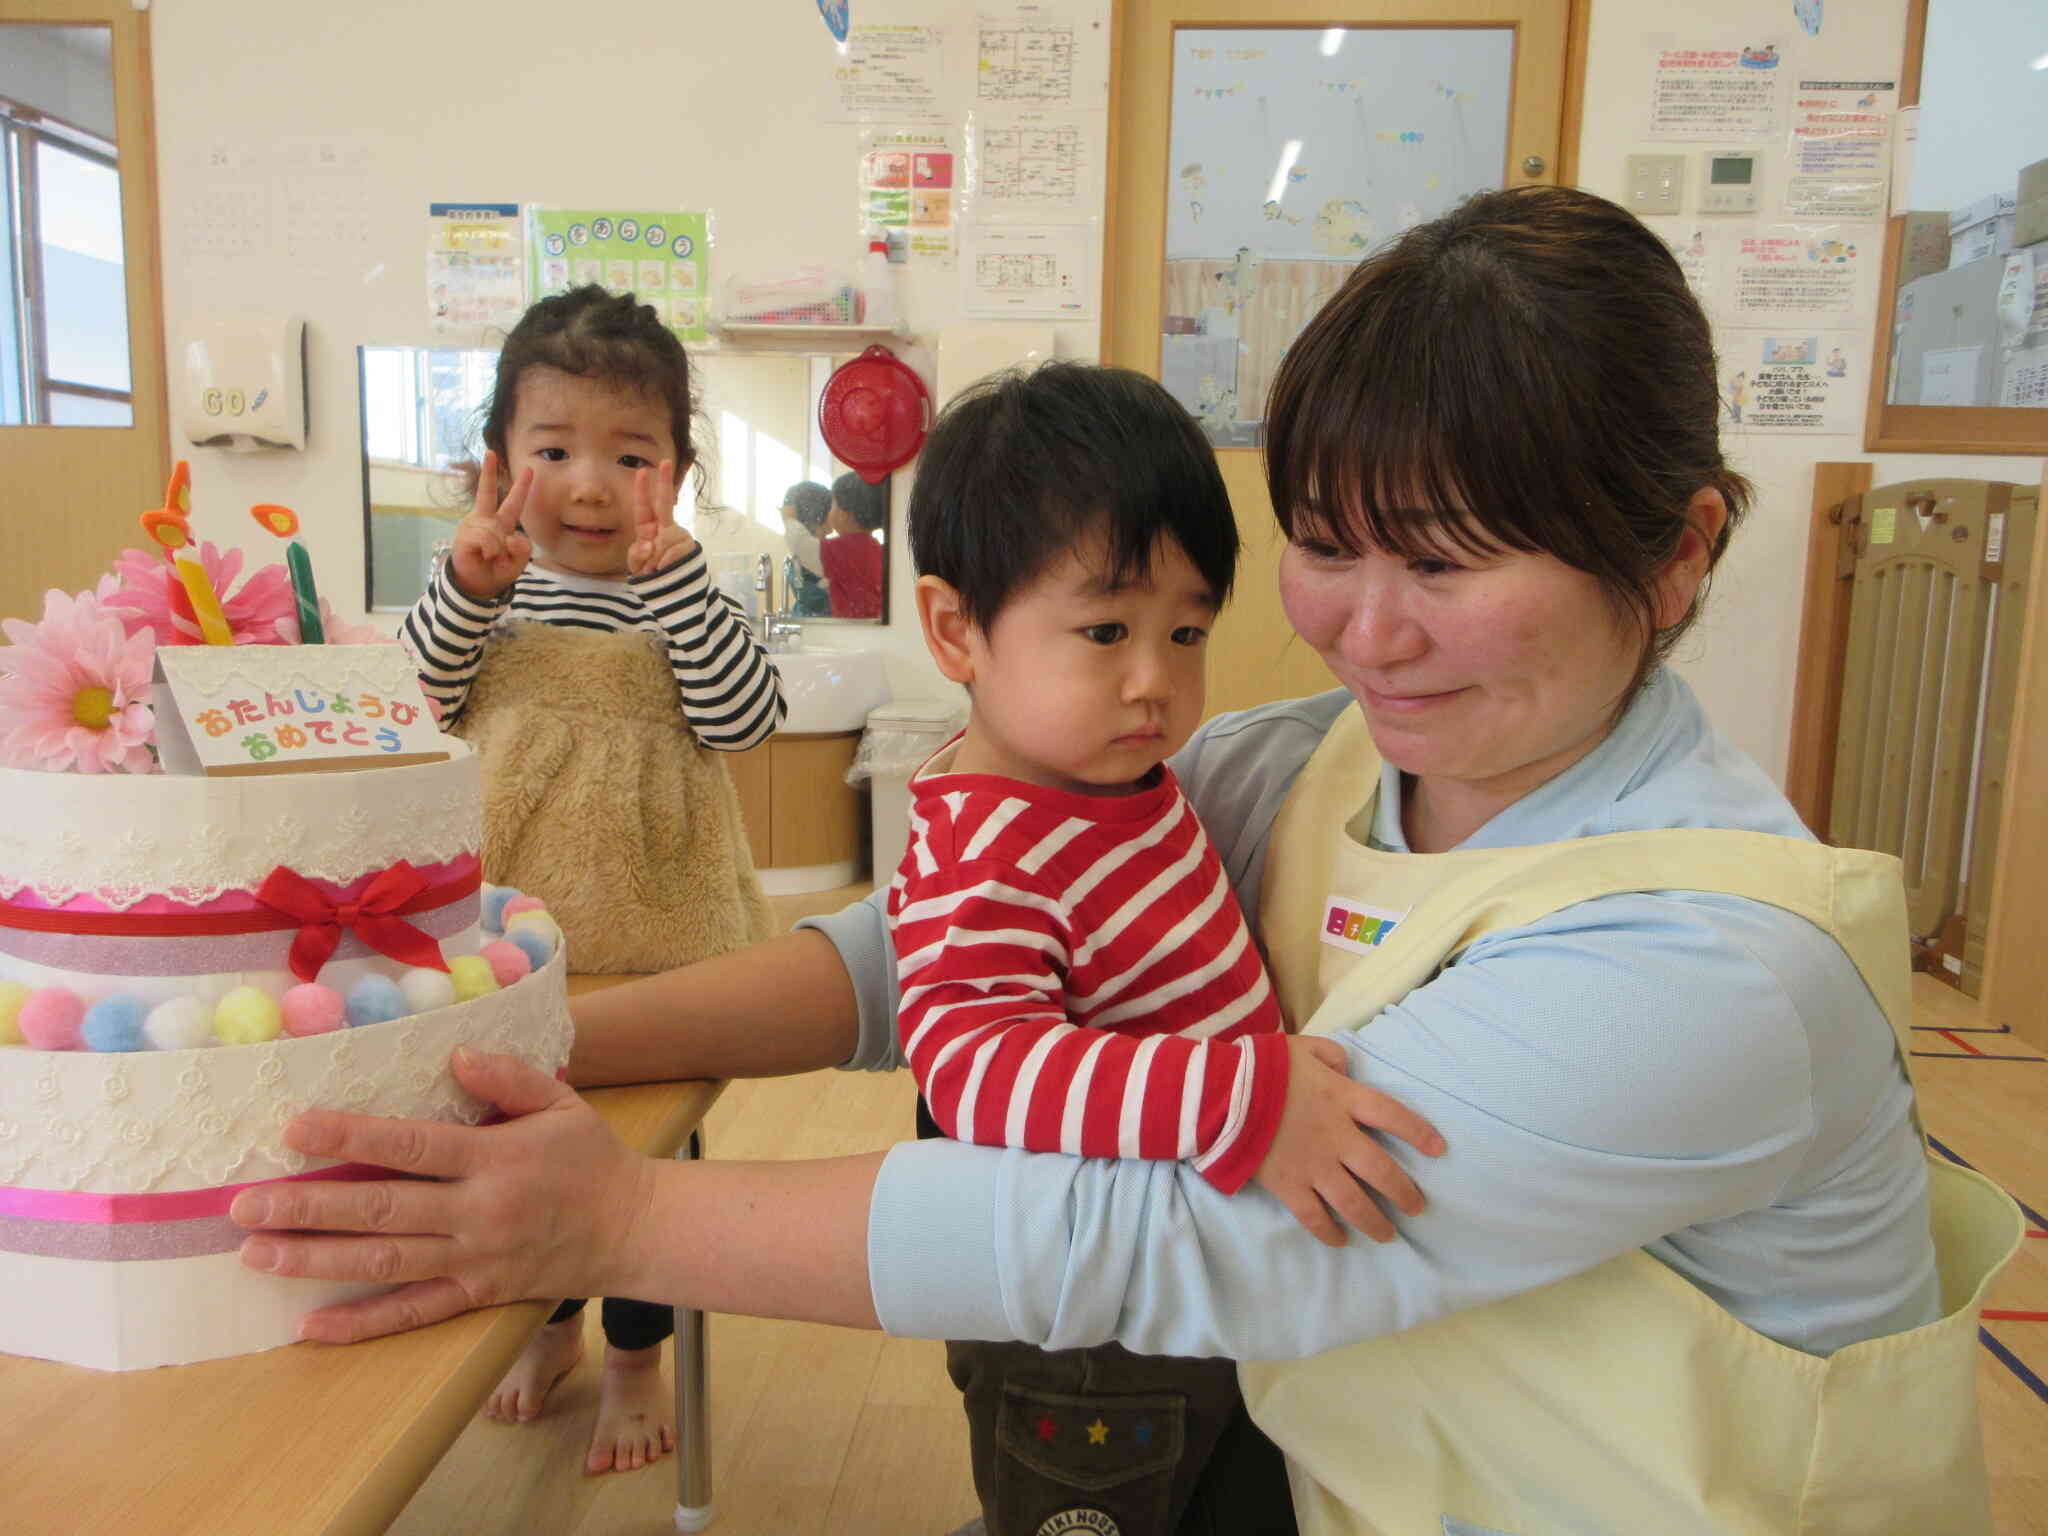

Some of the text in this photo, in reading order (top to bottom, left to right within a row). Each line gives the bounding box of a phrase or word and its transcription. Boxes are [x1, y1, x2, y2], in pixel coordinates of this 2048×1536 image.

[195, 689, 419, 737] おたんじょうび
[240, 721, 402, 761] おめでとう
